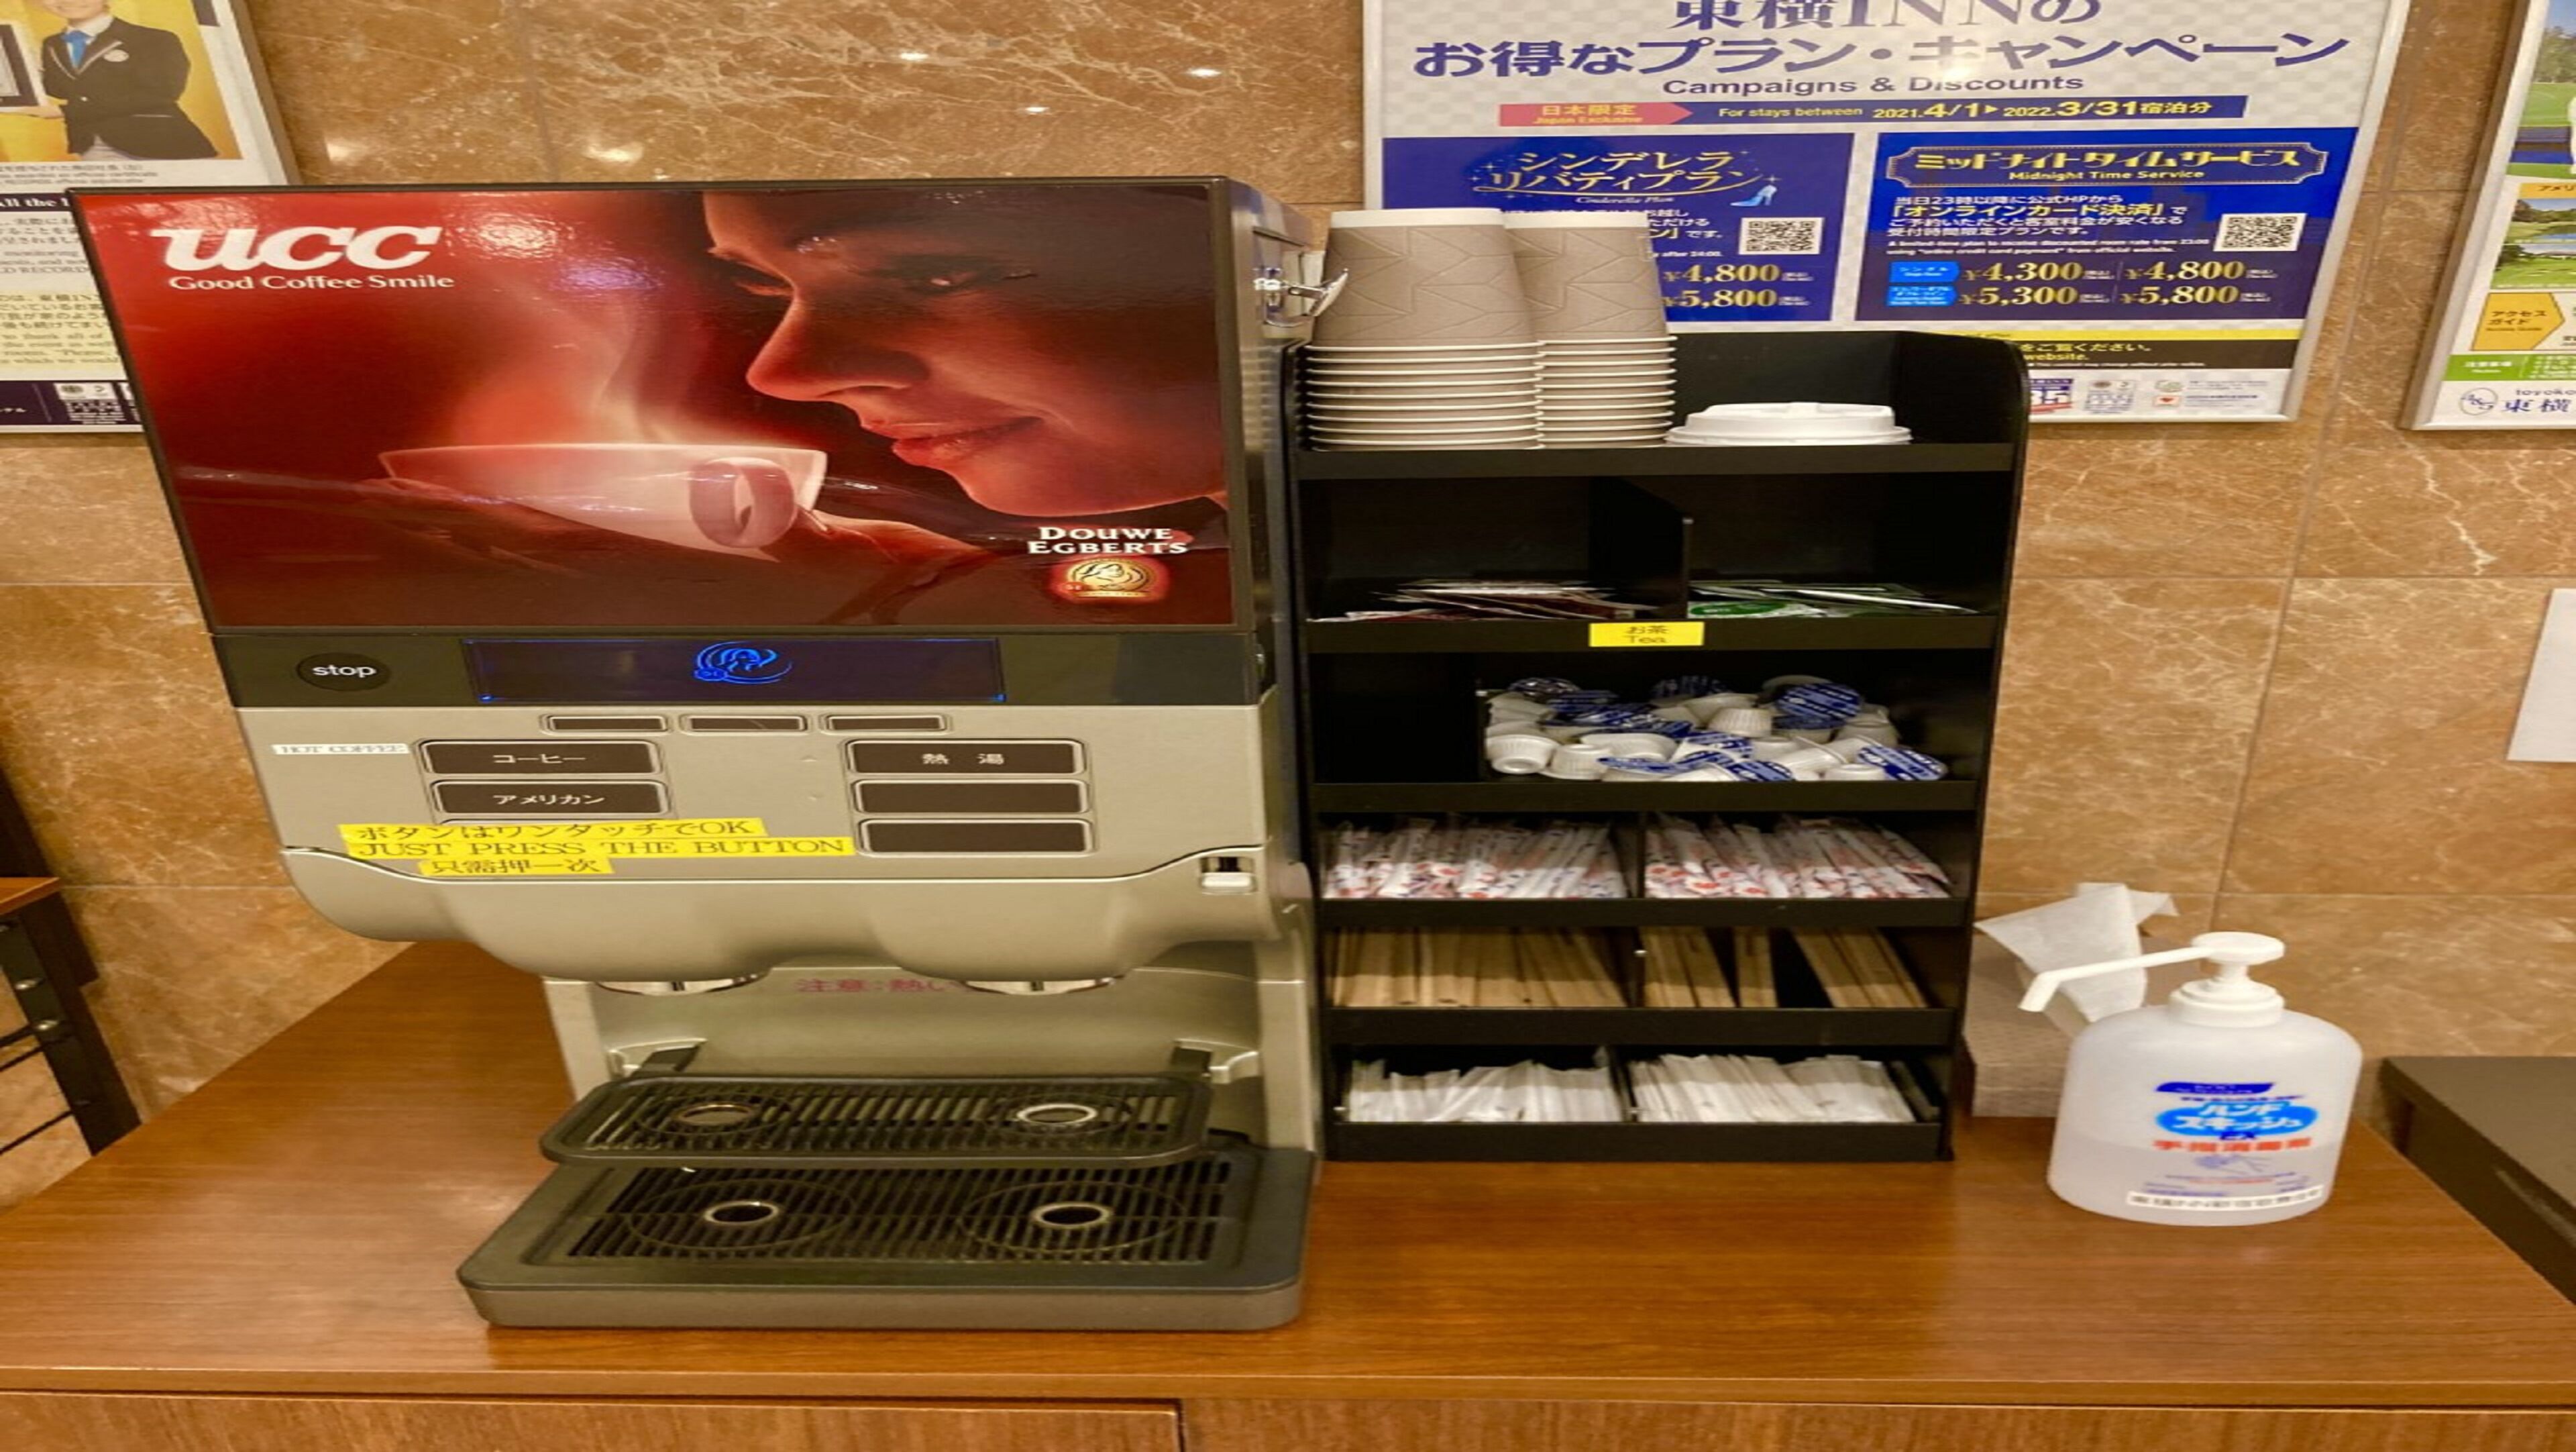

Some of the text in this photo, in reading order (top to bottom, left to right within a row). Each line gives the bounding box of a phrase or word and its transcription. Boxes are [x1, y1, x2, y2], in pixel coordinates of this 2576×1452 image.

[1668, 0, 2100, 30] 東横INNの
[1413, 33, 2351, 76] お得なプラン・キャンペーン
[1664, 76, 2084, 97] Campaigns & Discounts
[1542, 104, 1636, 117] 日本限定
[1718, 107, 1744, 117] For
[1748, 107, 1791, 119] stays
[1794, 106, 1862, 116] between
[1534, 116, 1576, 124] Japan
[1517, 151, 1734, 172] シンデレラ
[1914, 150, 2300, 169] ミッドナイトタイムサービス
[1490, 170, 1764, 191] リバティプラン
[2008, 170, 2205, 181] Midnight Time Service
[25, 198, 55, 207] the
[1575, 195, 1675, 204] Cinderella Plan
[1663, 264, 1780, 284] ¥4,800
[1964, 262, 2083, 282] ¥4,300
[2125, 260, 2245, 280] ¥4,800
[168, 274, 455, 291] Good Coffee Smile
[1958, 286, 2079, 306] ¥5,300
[2121, 285, 2239, 305] ¥5,800
[2023, 352, 2089, 361] website.
[1038, 526, 1174, 540] DOUWE
[1027, 540, 1189, 554] EGBERTS
[1626, 625, 1670, 635] お茶
[1623, 635, 1669, 644] Tea
[311, 664, 378, 678] stop
[280, 745, 405, 754] HOT COFFEE
[492, 754, 587, 765] コーヒー
[492, 794, 605, 805] アメリカン
[357, 820, 754, 841] ボタンはワンタッチでOK
[358, 839, 845, 857] JUST PRESS THE BUTTON
[431, 859, 602, 874] 只需押一次
[2198, 1103, 2285, 1117] ハンド
[2174, 1116, 2303, 1131] スキッシュ
